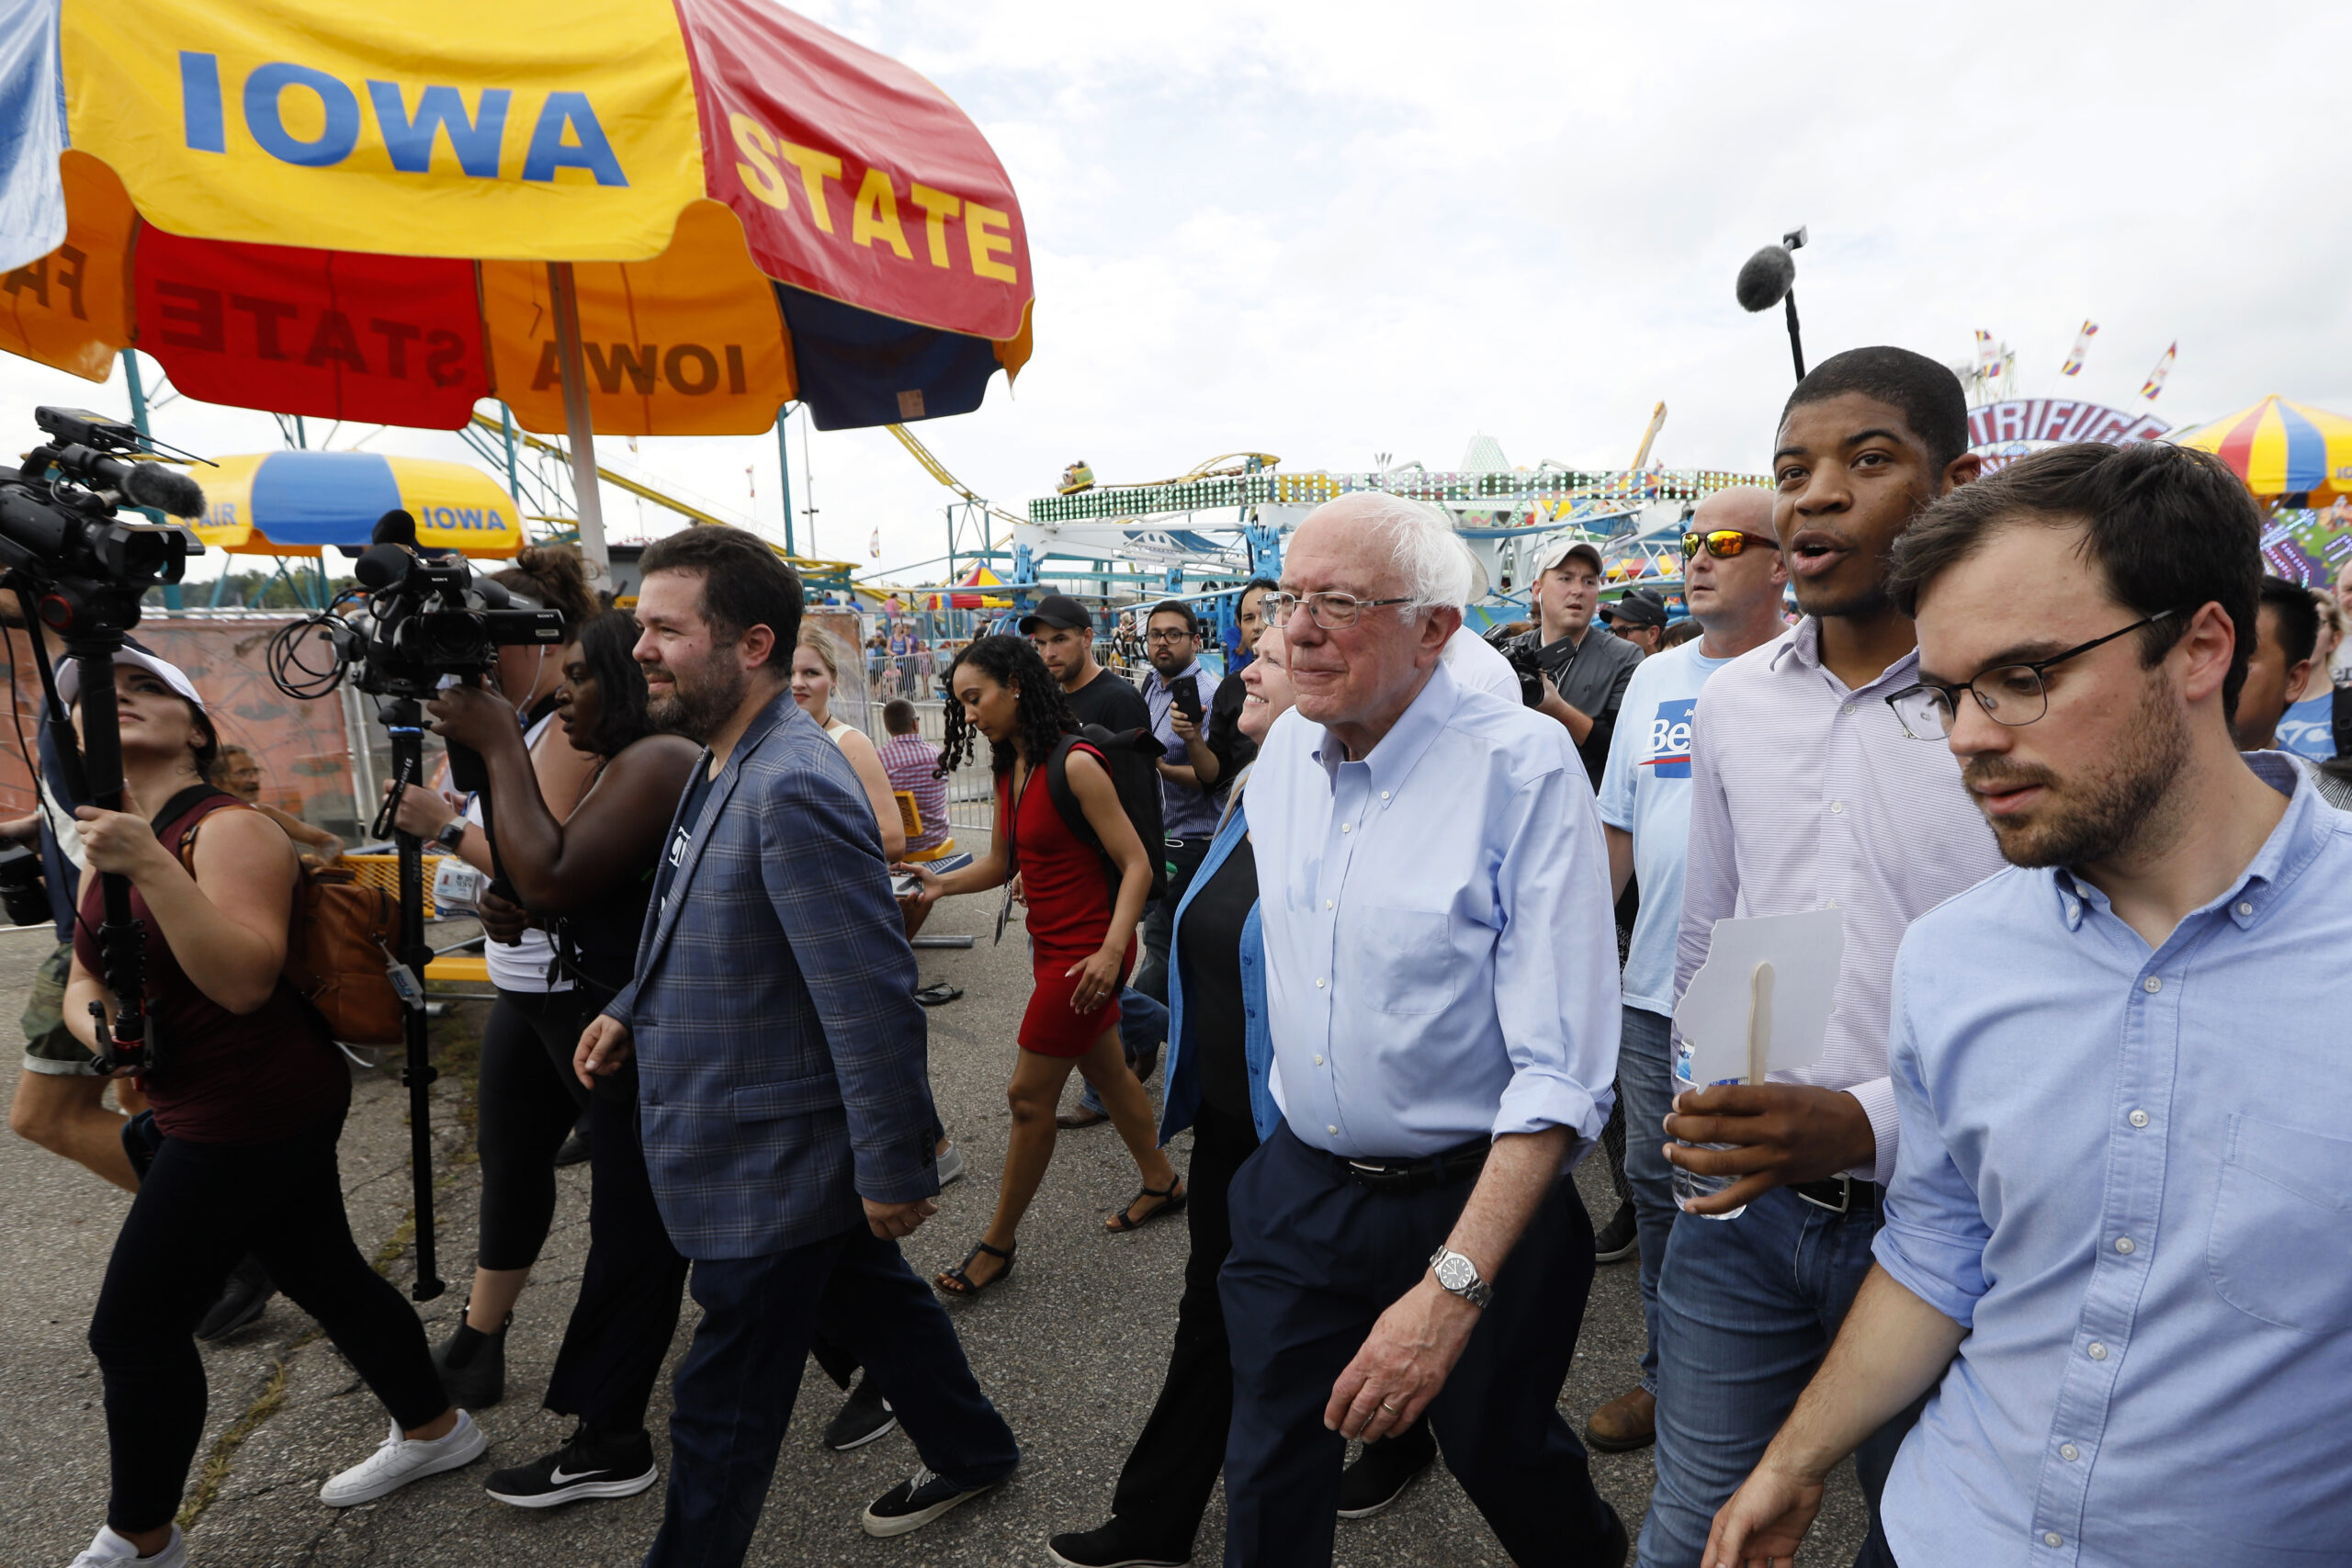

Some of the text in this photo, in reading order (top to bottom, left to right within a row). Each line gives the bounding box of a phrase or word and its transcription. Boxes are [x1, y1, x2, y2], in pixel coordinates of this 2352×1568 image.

[178, 50, 630, 187] IOWA
[729, 112, 1017, 285] STATE
[186, 502, 237, 528] AIR
[422, 506, 507, 531] IOWA
